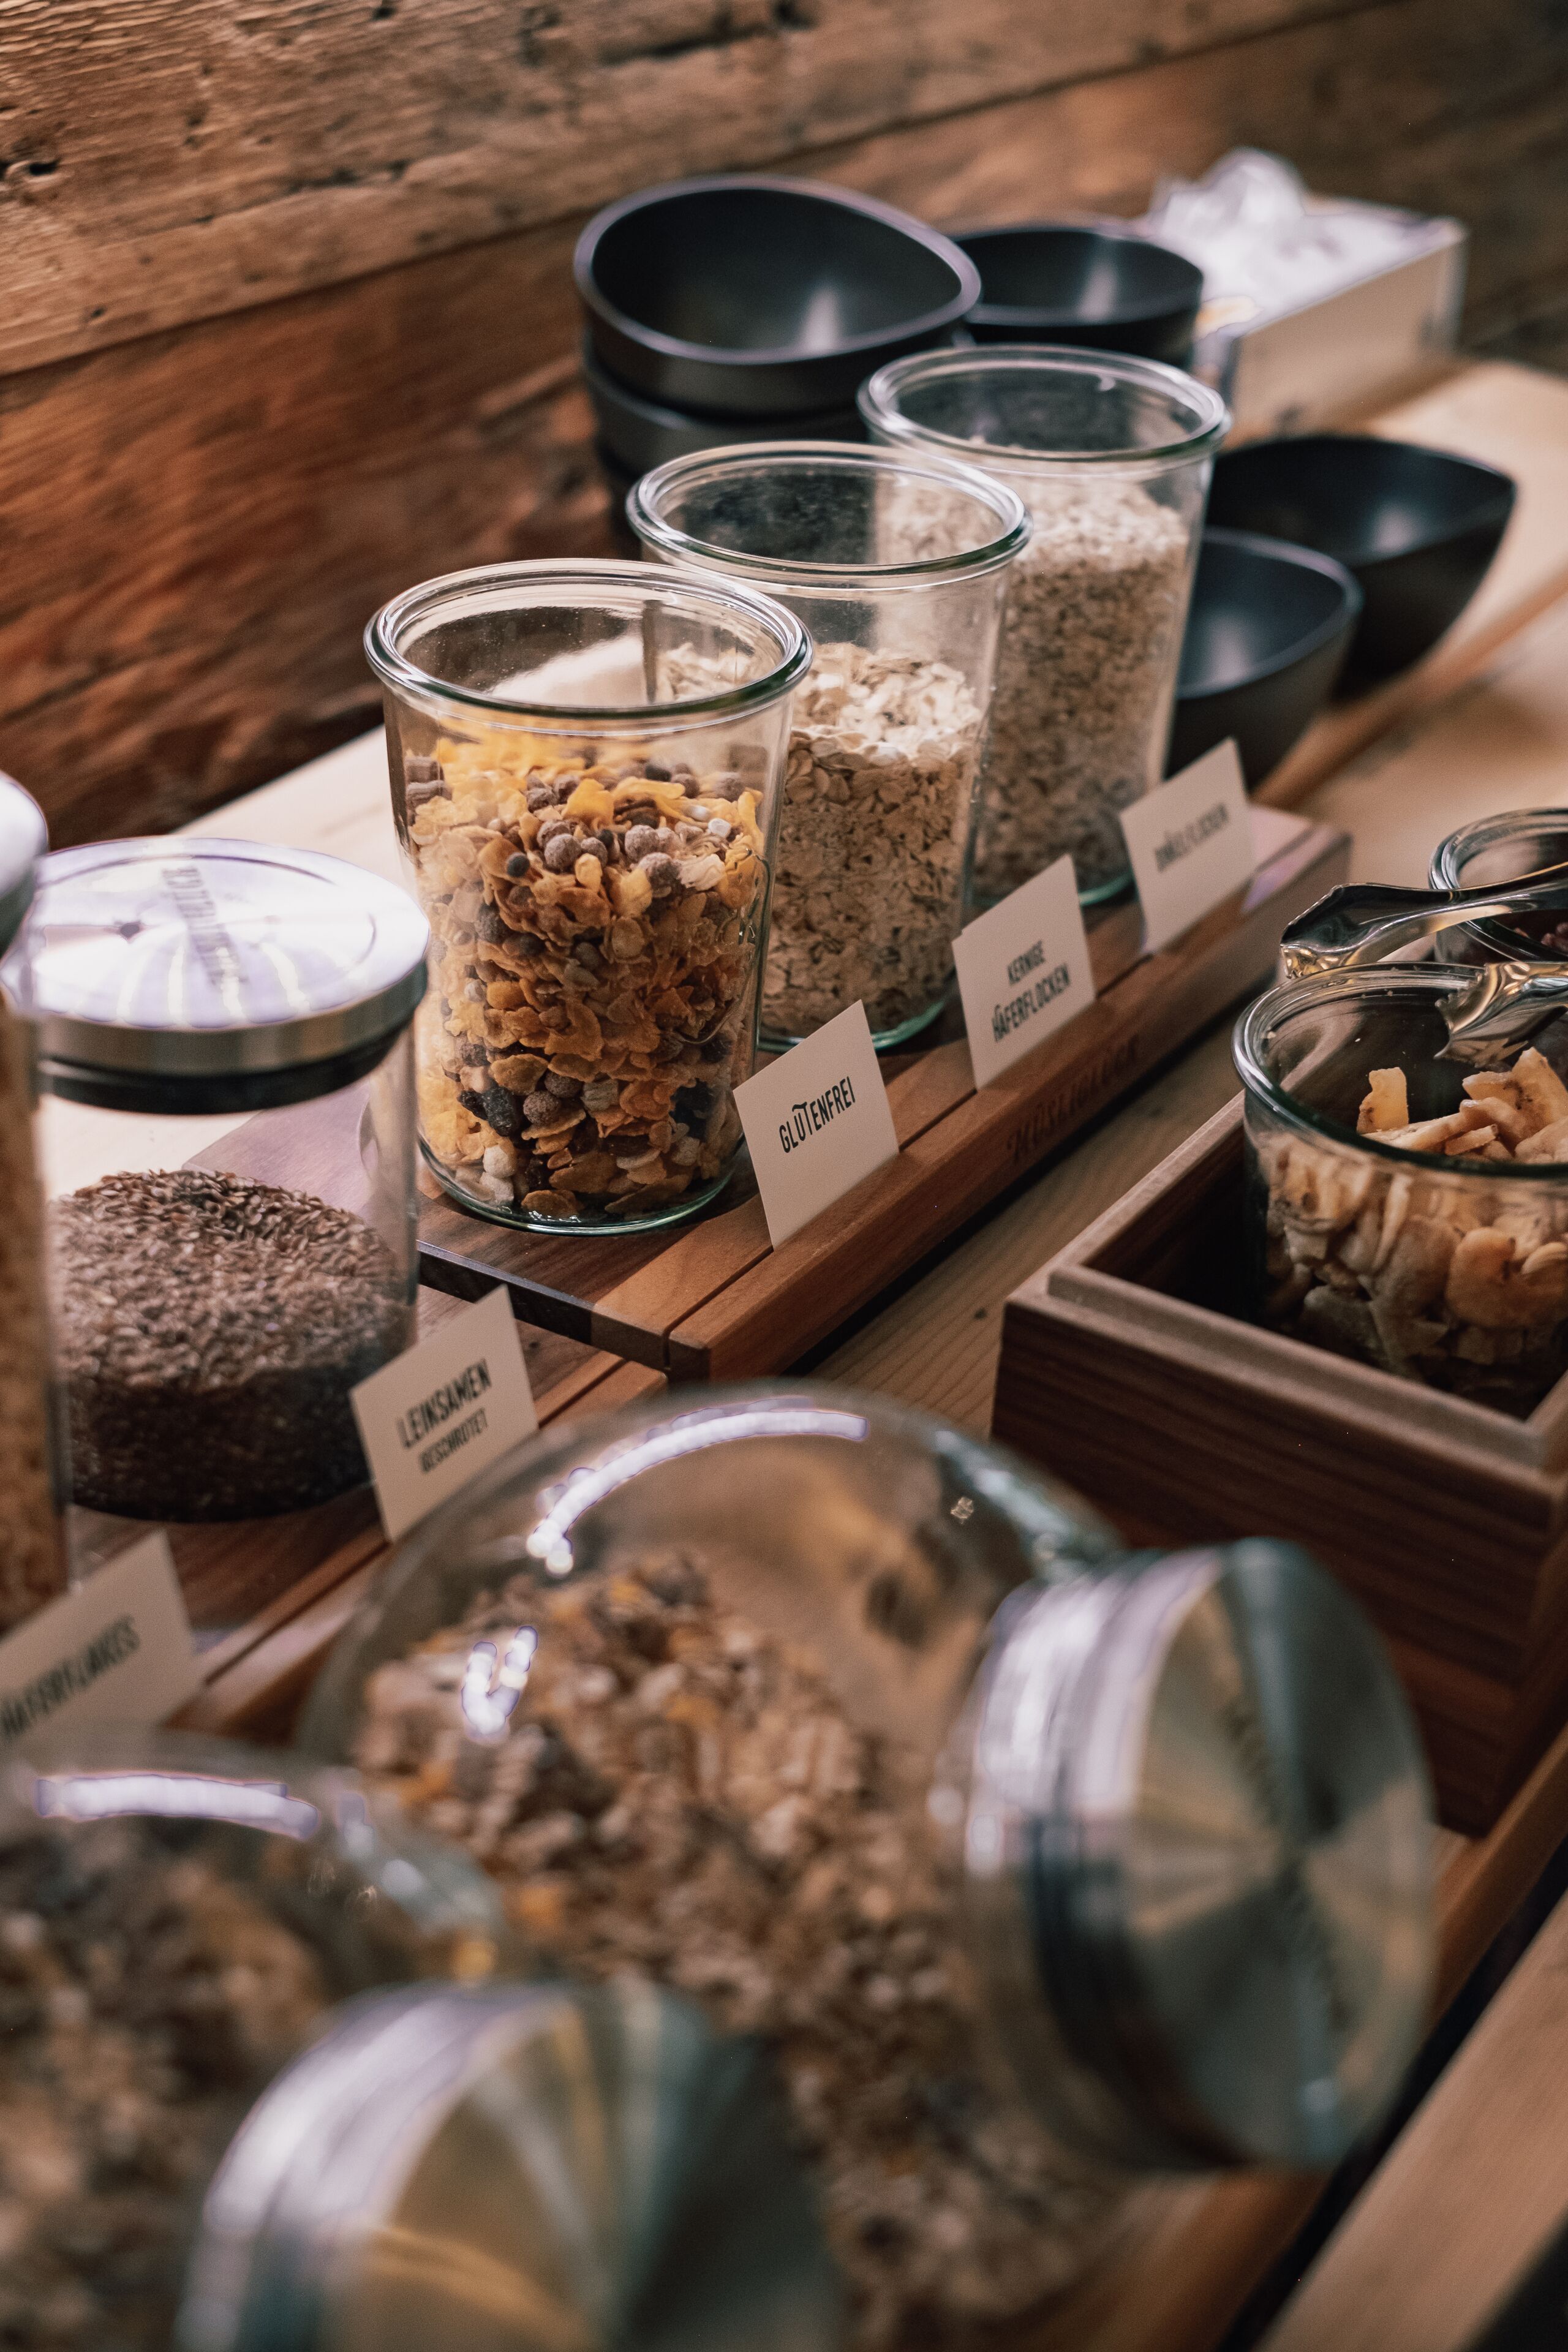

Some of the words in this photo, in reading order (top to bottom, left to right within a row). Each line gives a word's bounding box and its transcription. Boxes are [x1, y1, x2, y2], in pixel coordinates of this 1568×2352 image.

[1006, 940, 1045, 985] KERNIGE
[778, 1076, 856, 1153] GLUTENFREI
[398, 1358, 492, 1450] LEINSAMEN
[420, 1408, 488, 1474] GESCHROTET
